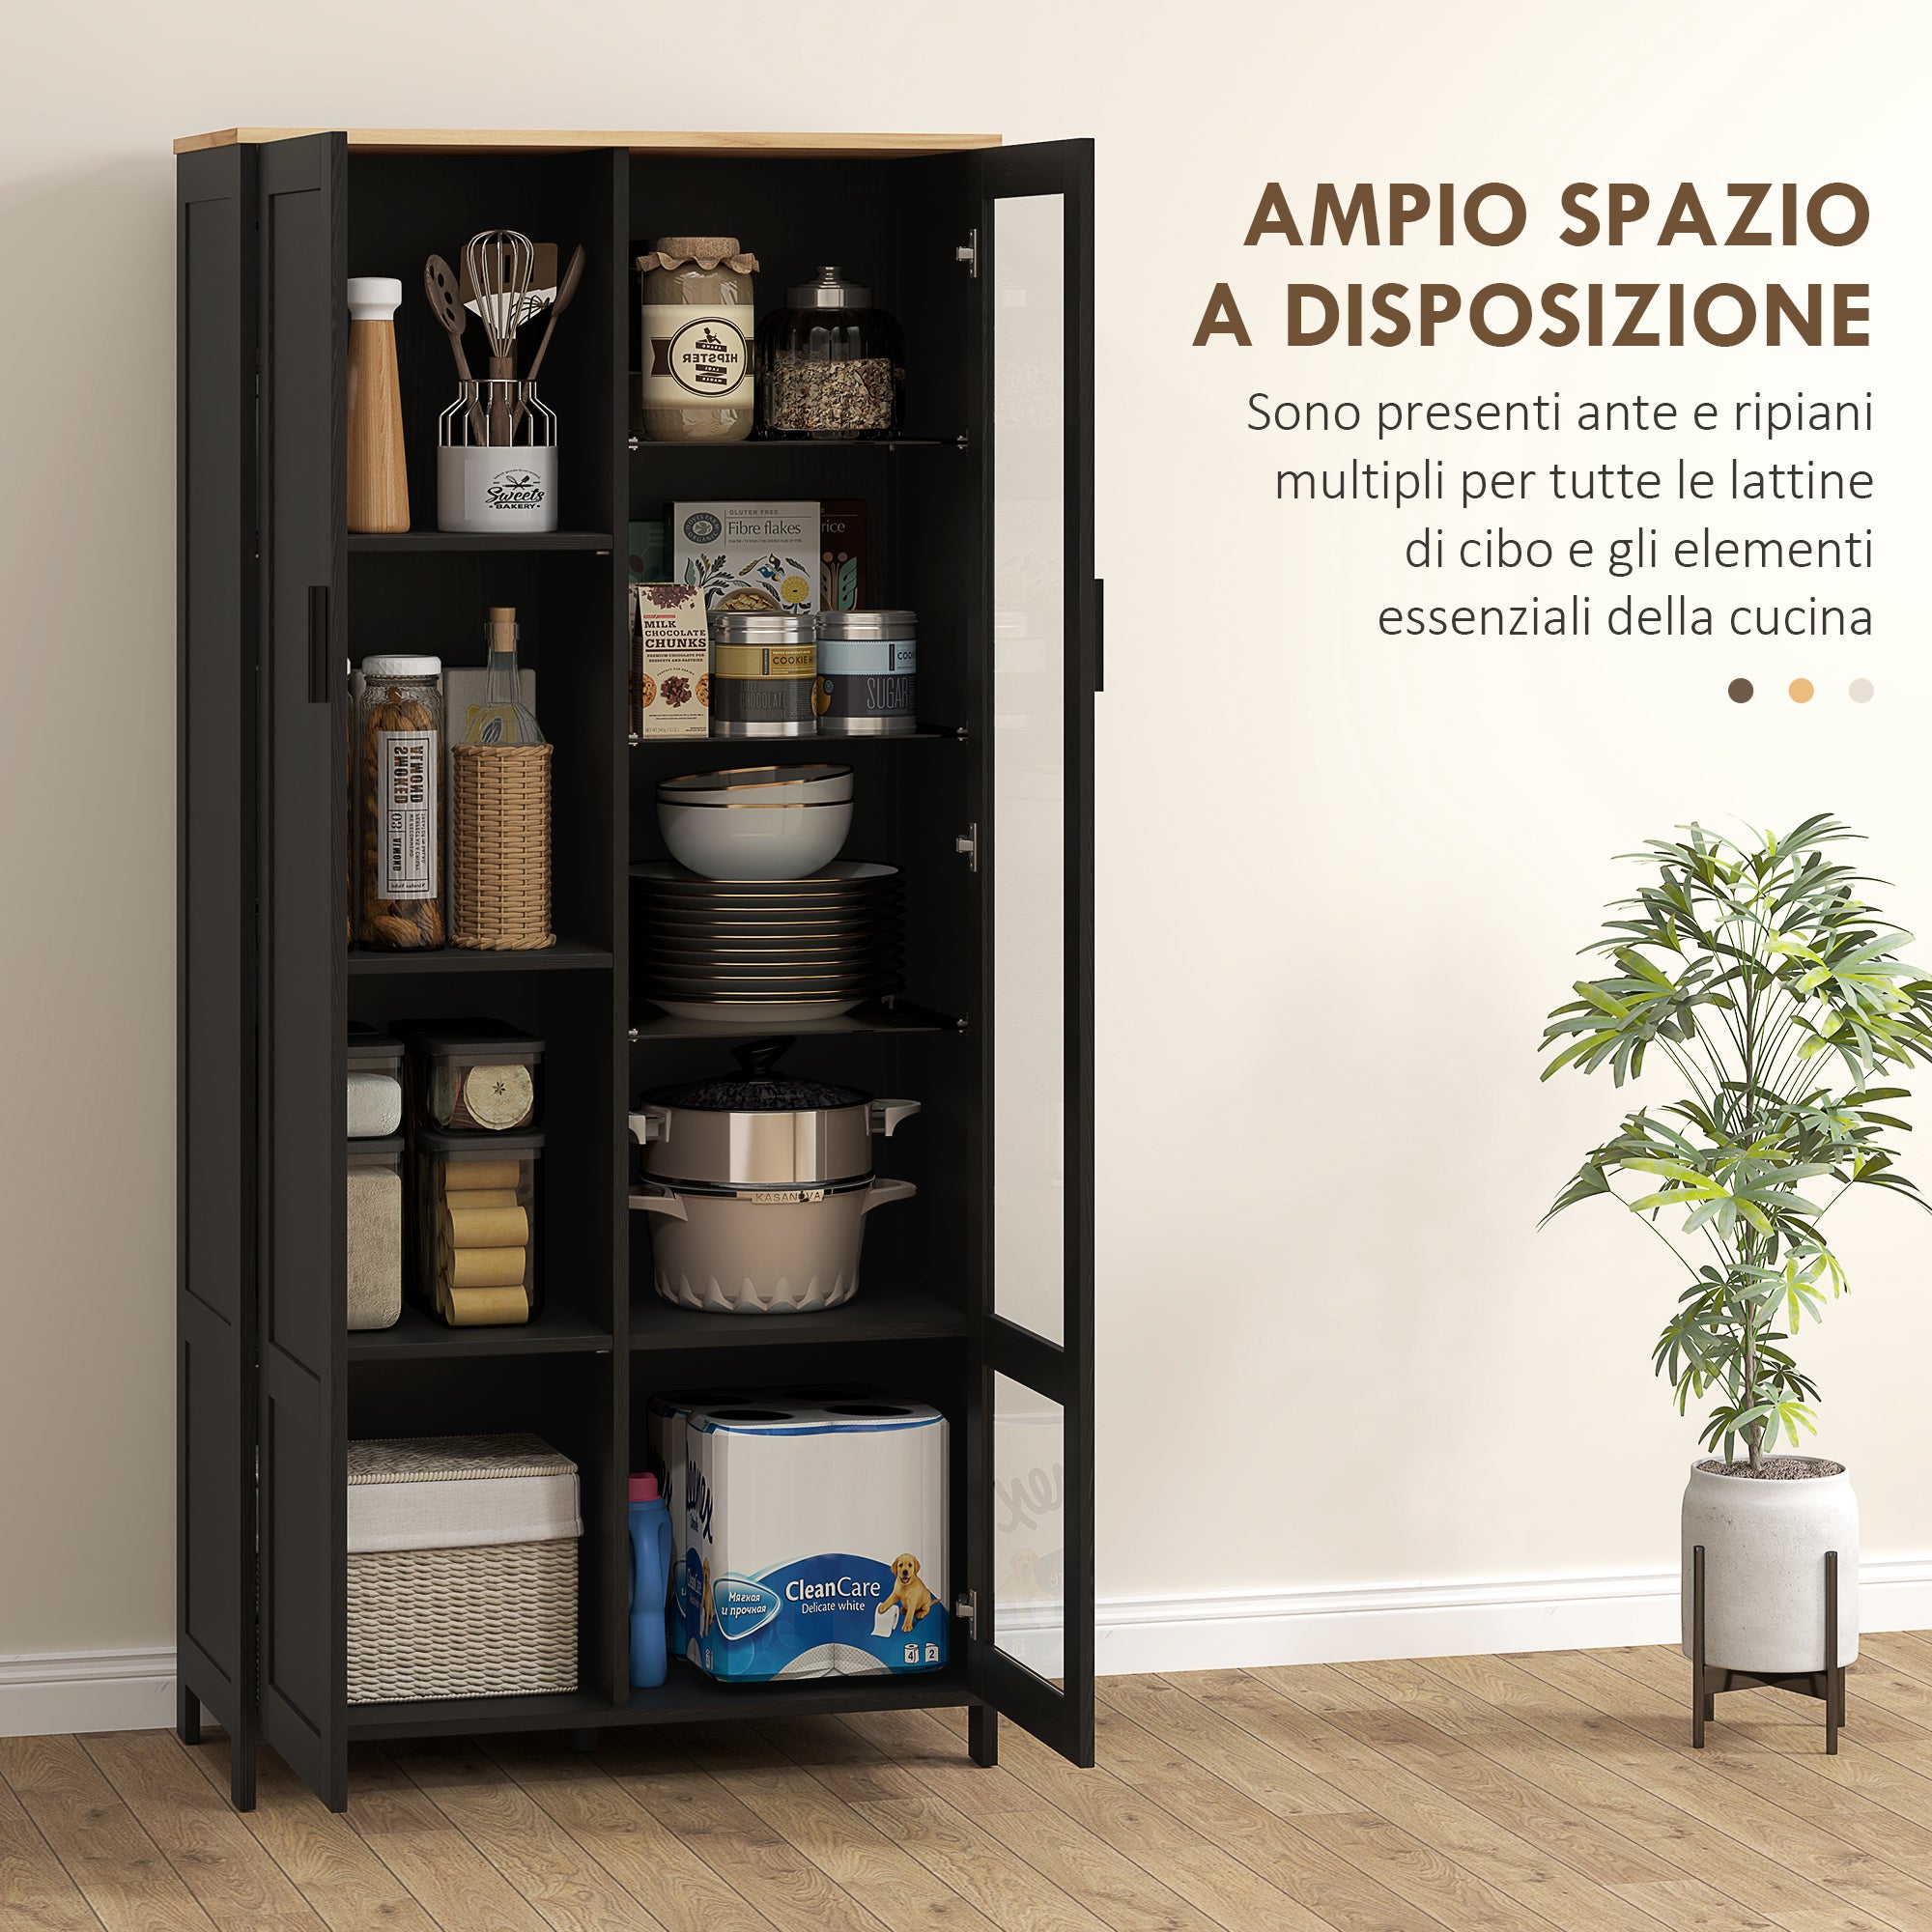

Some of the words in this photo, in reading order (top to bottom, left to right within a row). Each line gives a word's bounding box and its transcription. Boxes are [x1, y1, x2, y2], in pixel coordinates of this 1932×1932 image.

[485, 486, 545, 505] Sweets
[728, 521, 760, 535] Fibre
[764, 520, 801, 535] flakes
[687, 531, 719, 543] ORGANIC
[645, 639, 706, 648] CHUNKS
[773, 656, 808, 665] COOKIE
[867, 677, 908, 709] SUGAR
[755, 1191, 821, 1203] KASANOVA
[785, 1577, 881, 1602] CleanCare
[728, 1591, 761, 1603] Мягкая
[721, 1606, 728, 1616] и
[729, 1605, 767, 1618] прочная
[802, 1602, 836, 1614] Delicate
[838, 1600, 866, 1611] white
[908, 1651, 914, 1661] 4
[929, 1649, 935, 1659] 2
